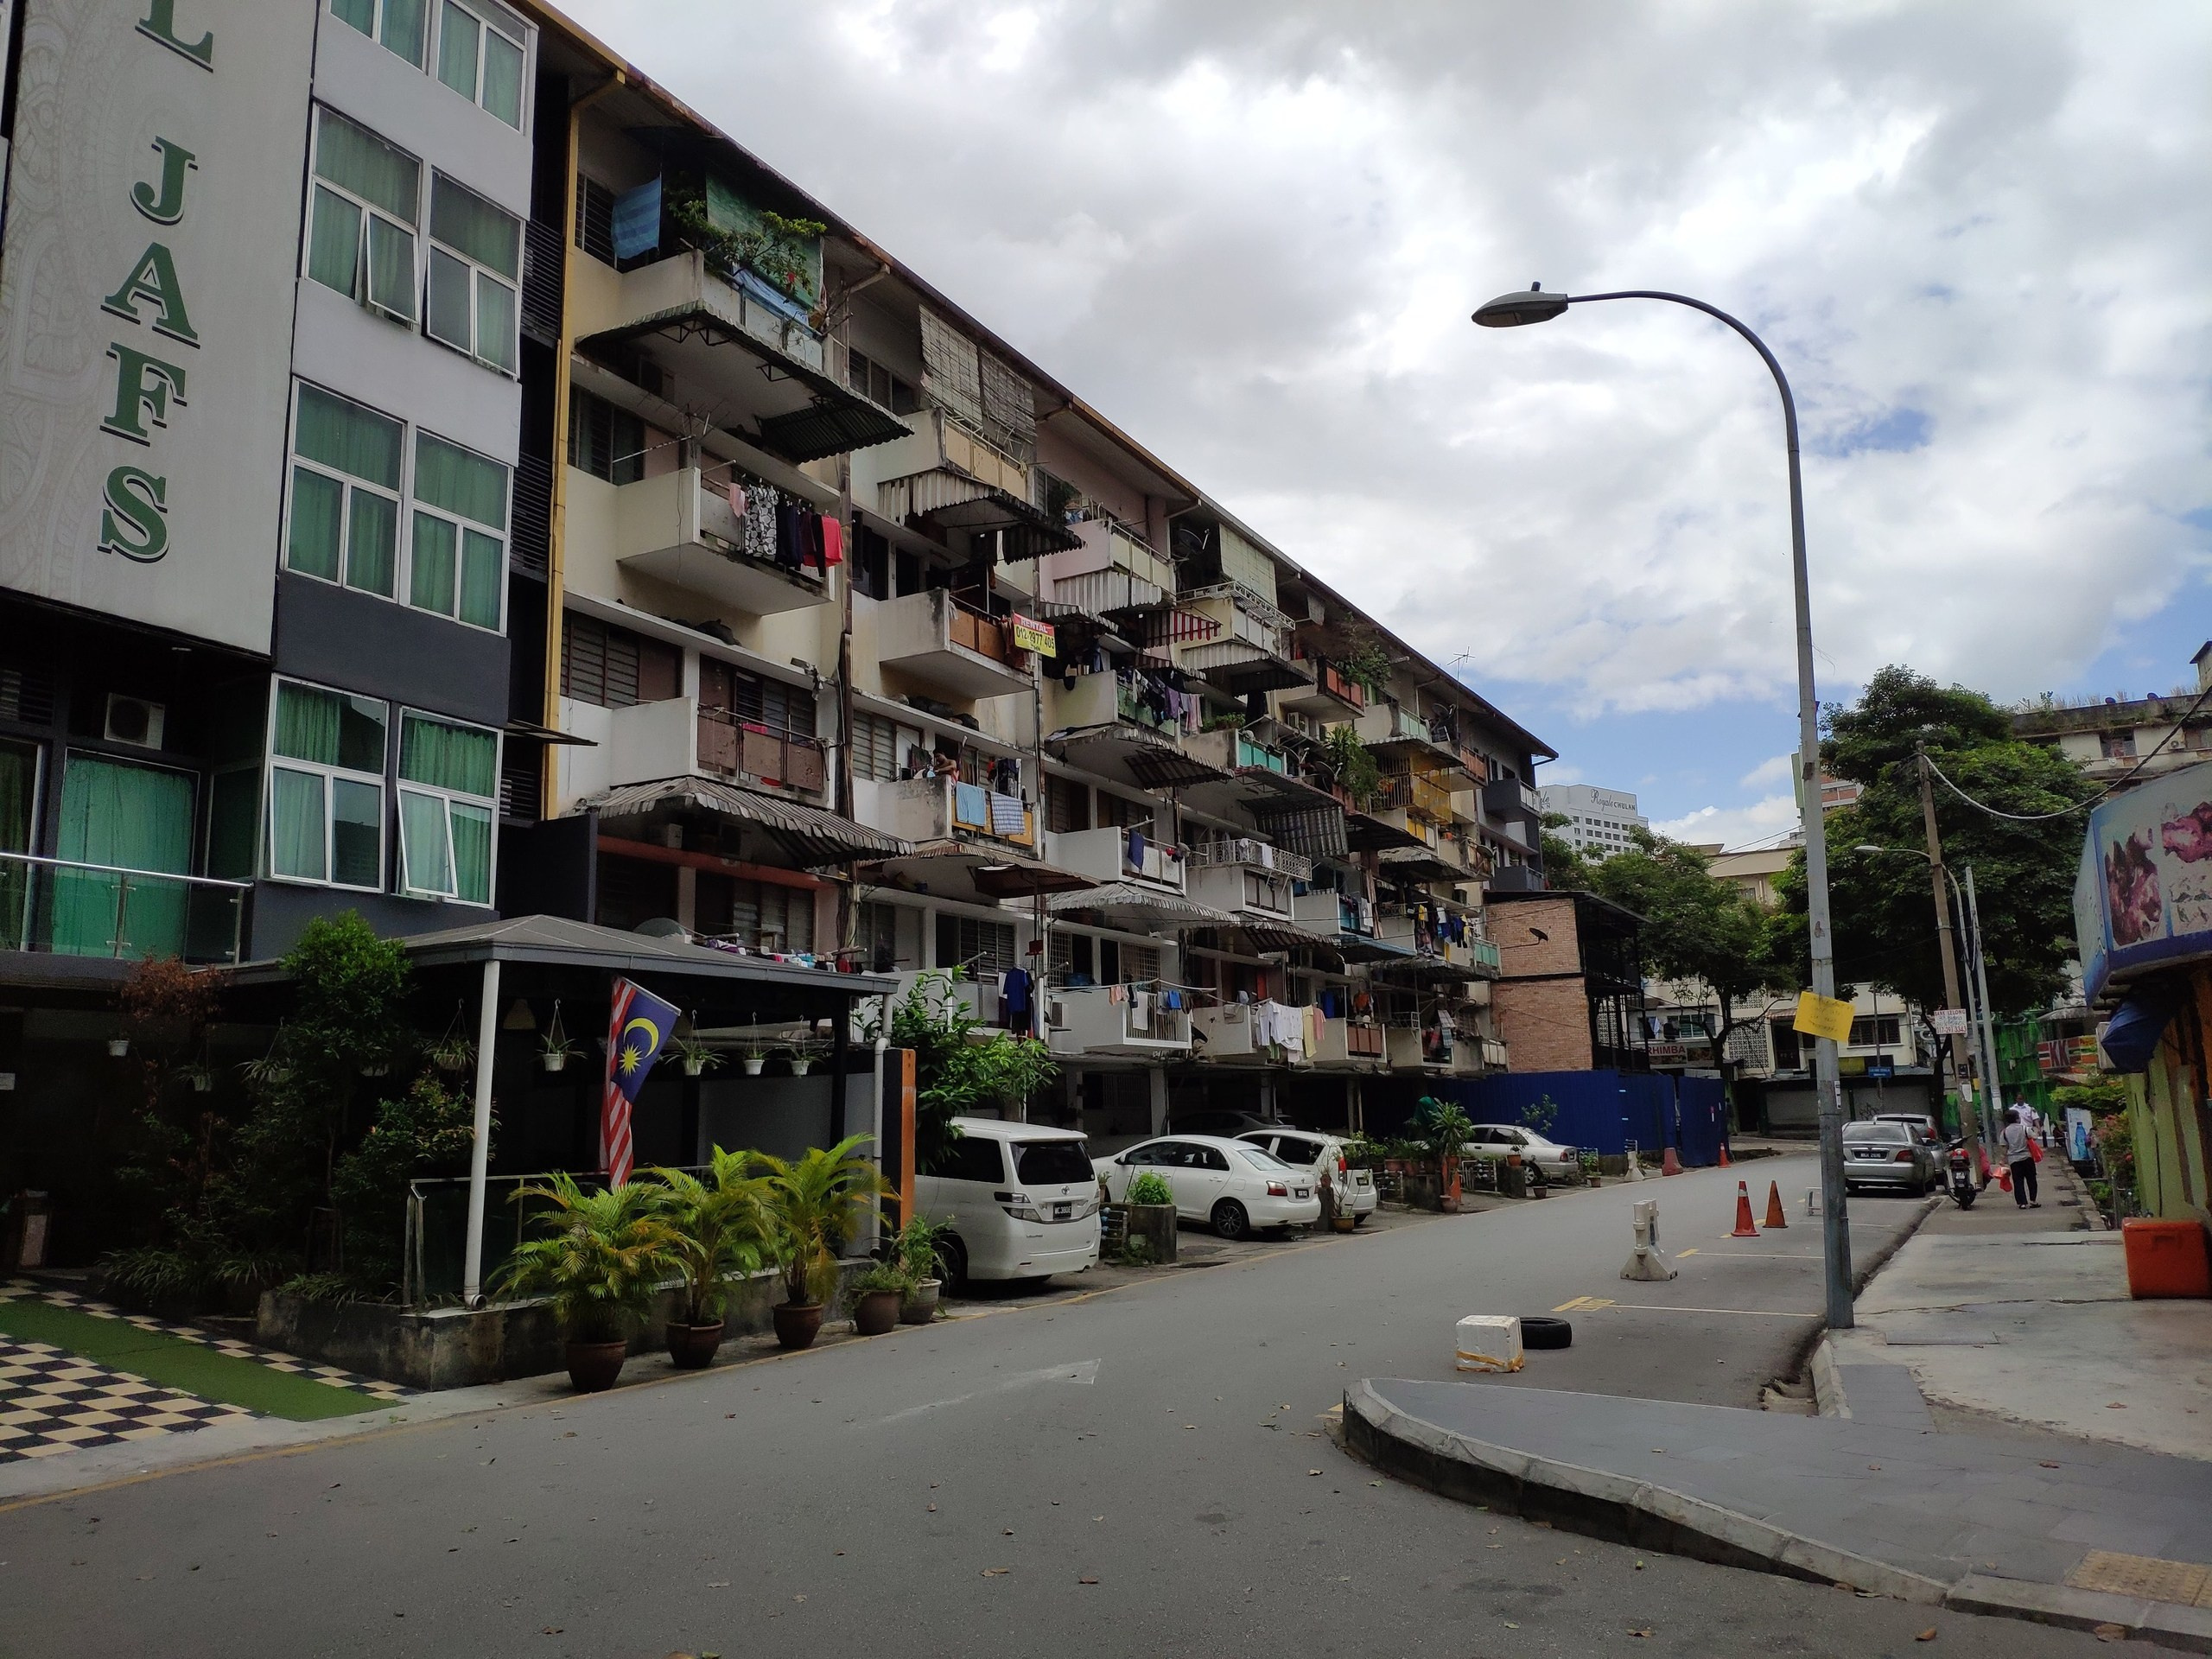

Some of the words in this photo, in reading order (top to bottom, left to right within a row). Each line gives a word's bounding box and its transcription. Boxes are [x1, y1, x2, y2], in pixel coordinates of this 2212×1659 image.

[98, 136, 200, 564] JAFS
[1020, 618, 1048, 634] RENTAL
[1591, 788, 1613, 811] Royale
[2049, 1039, 2070, 1068] KK
